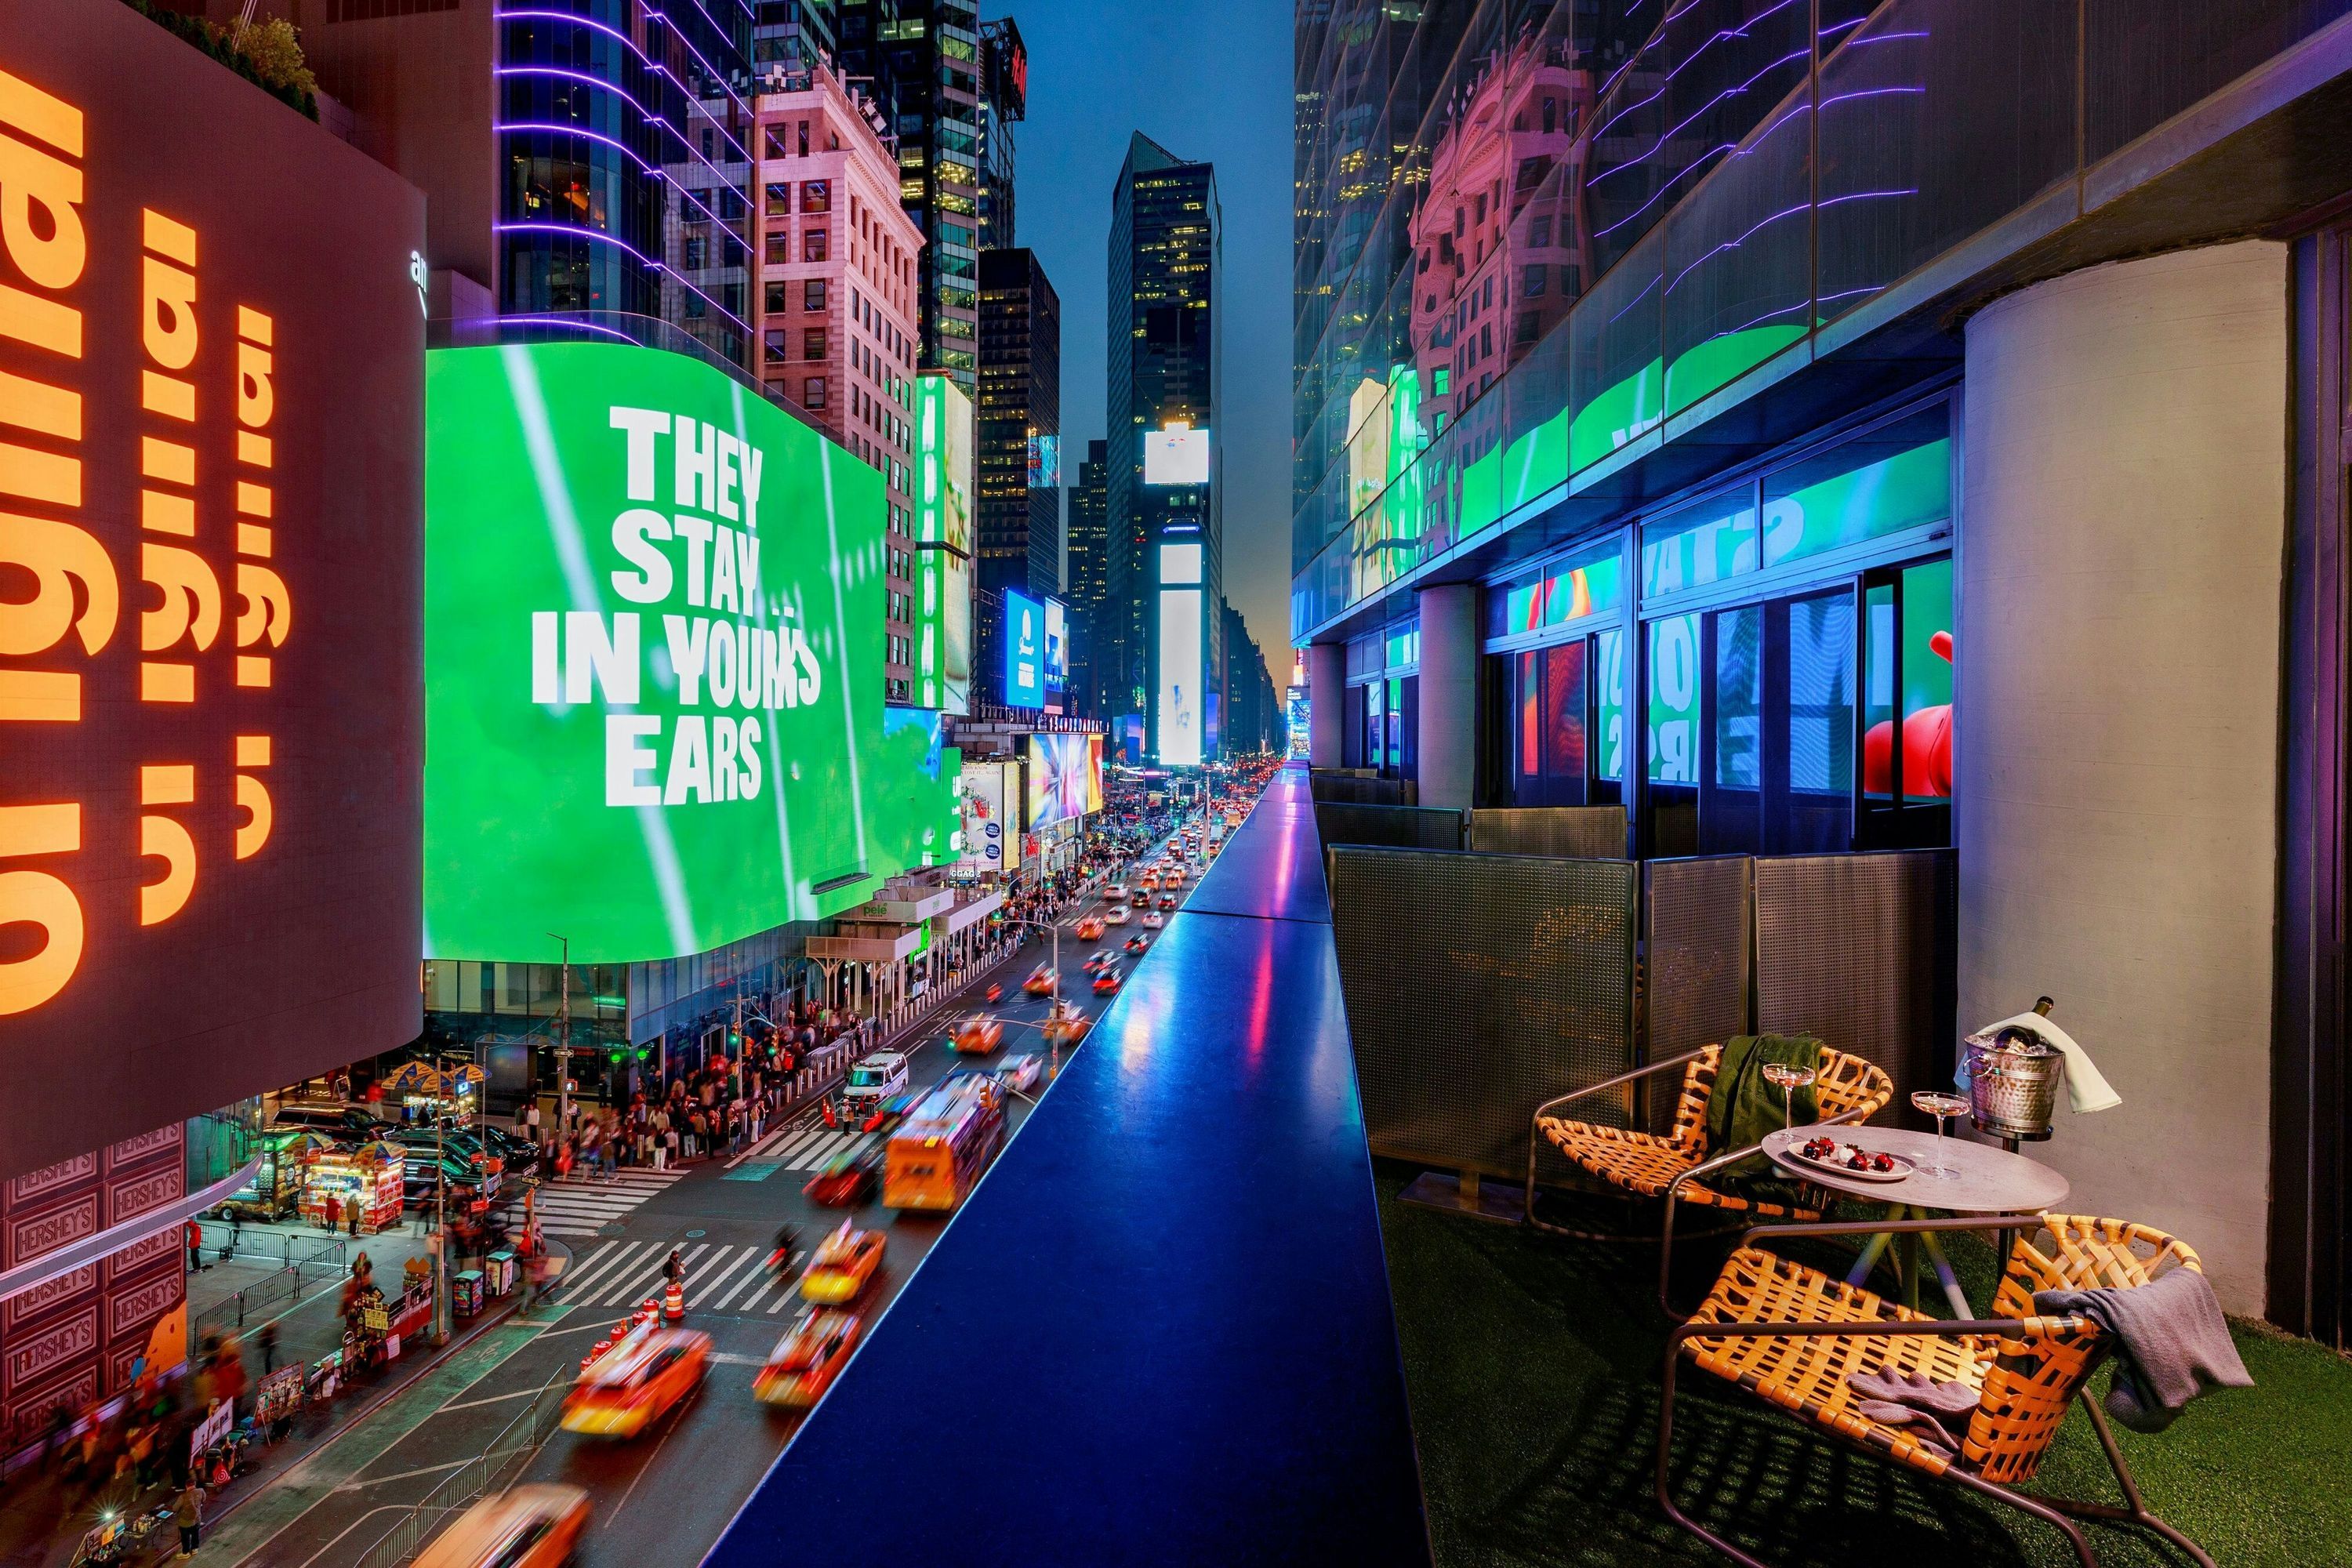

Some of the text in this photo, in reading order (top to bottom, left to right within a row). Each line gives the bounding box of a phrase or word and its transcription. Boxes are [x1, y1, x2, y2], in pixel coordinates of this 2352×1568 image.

[608, 405, 763, 528] THEY
[611, 508, 760, 618] STAY
[532, 611, 641, 704] IN
[605, 714, 762, 807] EARS
[863, 903, 887, 916] pelé
[116, 1172, 180, 1216] HERSHEY'S
[19, 1206, 93, 1254] HERSHEY'S
[116, 1277, 180, 1326] HERSHEY'S
[18, 1319, 91, 1374] HERSHEY'S
